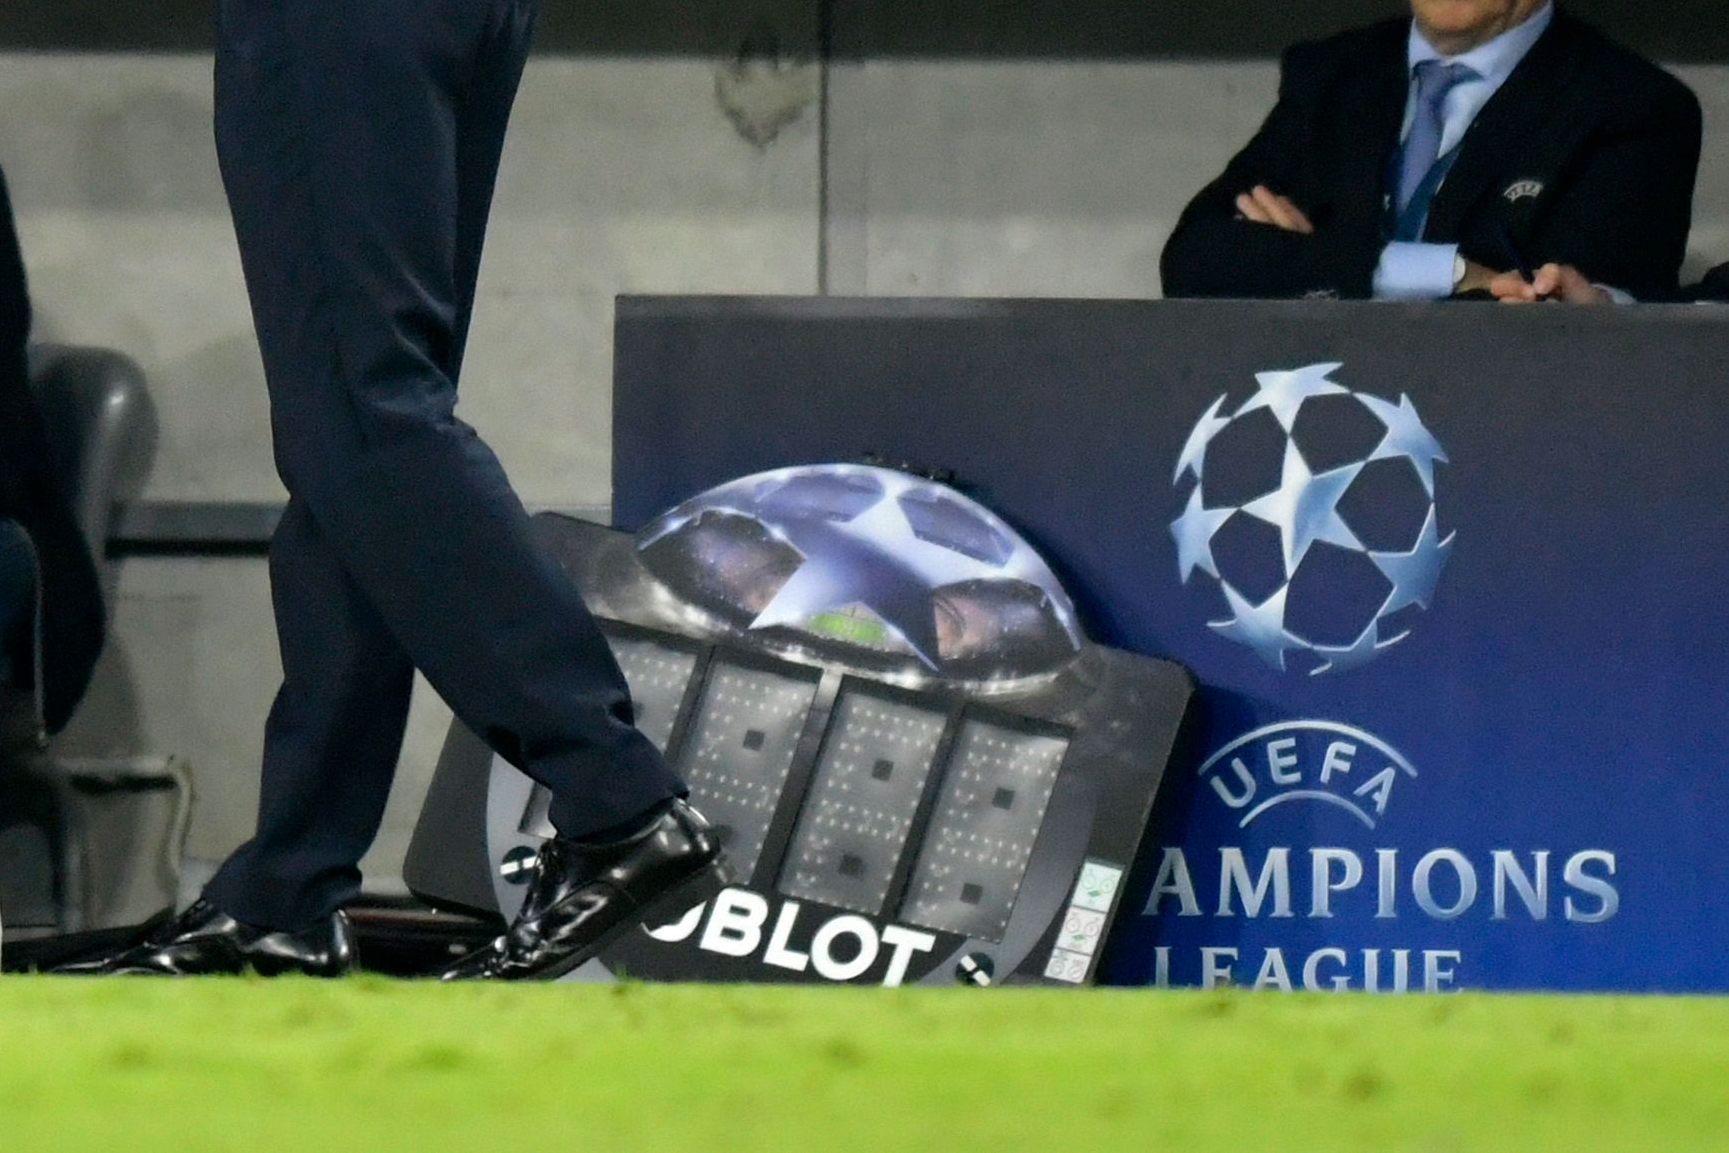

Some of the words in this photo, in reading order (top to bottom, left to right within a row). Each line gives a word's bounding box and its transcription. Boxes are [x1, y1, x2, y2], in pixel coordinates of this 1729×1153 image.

[1210, 737, 1396, 816] UEFA
[1141, 846, 1620, 924] AMPIONS
[640, 887, 937, 988] BLOT
[1155, 947, 1465, 994] LEAGUE
